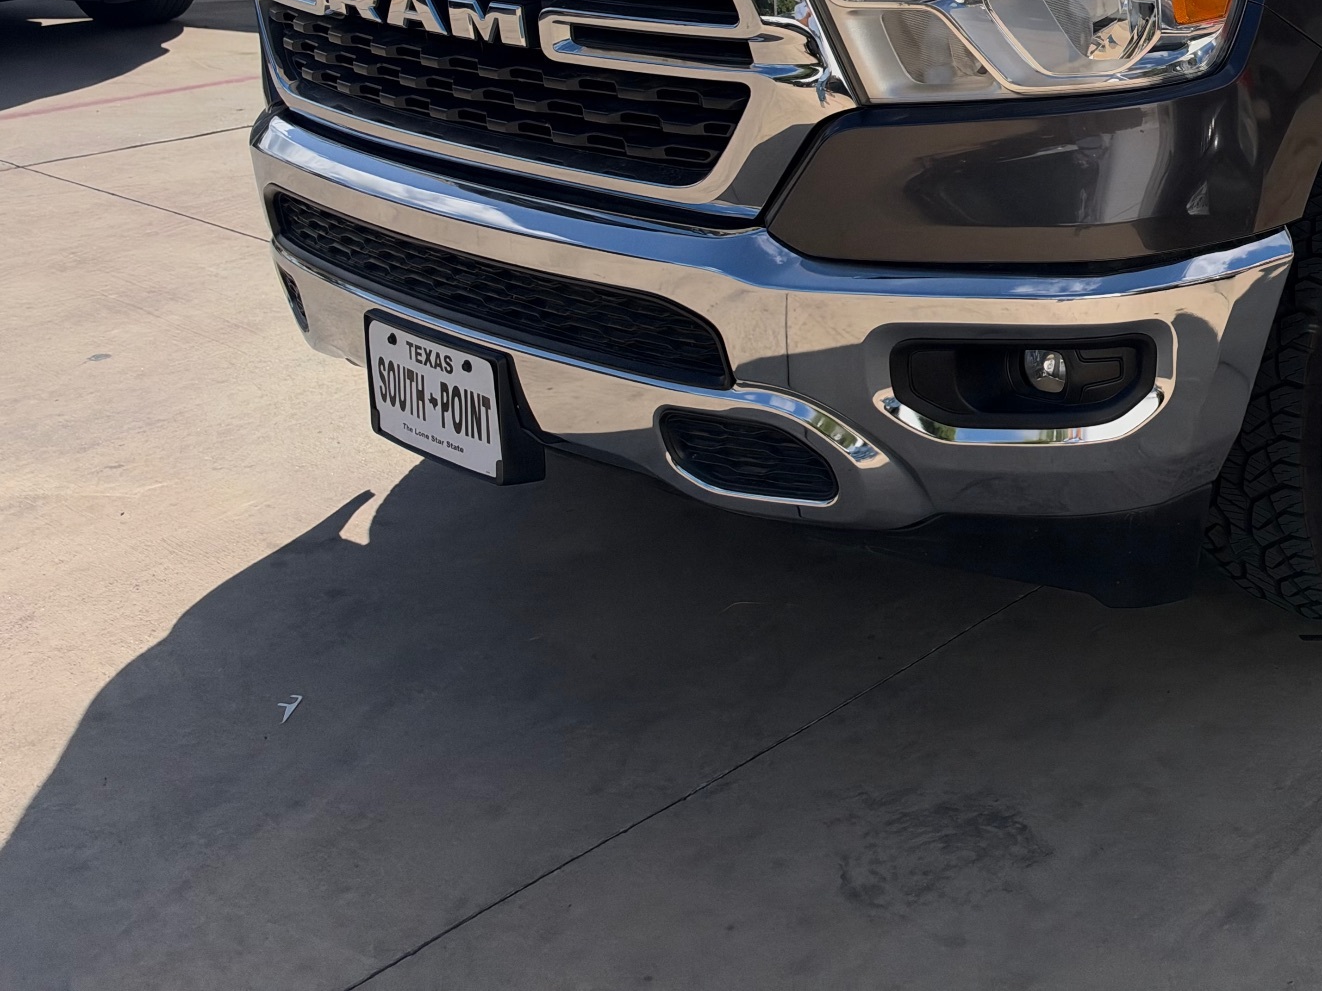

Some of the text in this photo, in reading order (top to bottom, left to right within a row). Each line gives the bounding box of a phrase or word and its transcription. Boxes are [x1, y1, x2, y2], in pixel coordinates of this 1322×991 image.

[406, 340, 454, 375] TEXAS
[378, 356, 492, 445] SOUTH POINT
[402, 422, 465, 454] The Lone Star State
